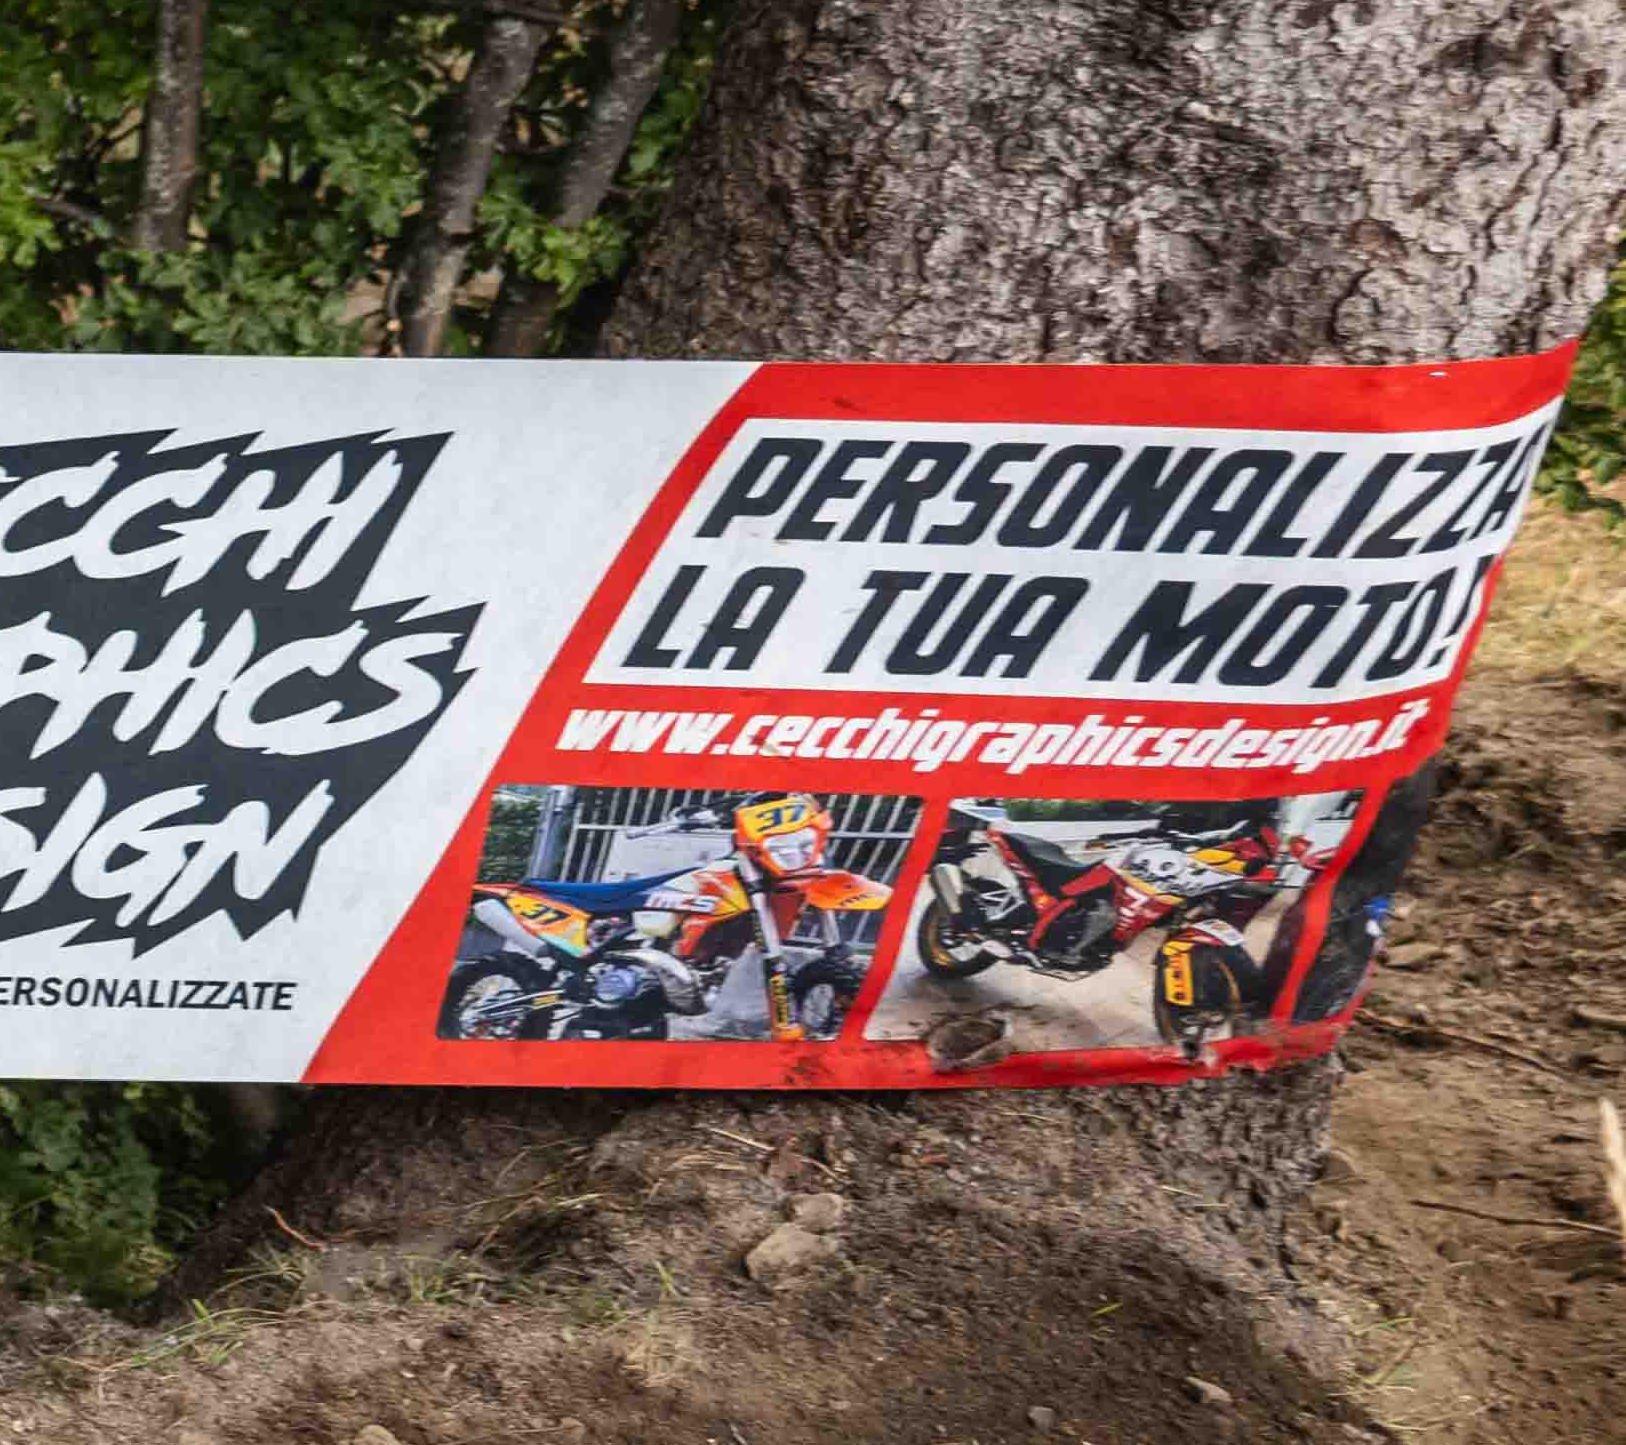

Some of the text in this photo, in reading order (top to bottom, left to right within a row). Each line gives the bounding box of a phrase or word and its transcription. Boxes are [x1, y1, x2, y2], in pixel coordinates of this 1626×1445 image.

[696, 418, 1553, 559] PERSONALIZZA
[620, 554, 1499, 689] LA TUA MOTO!
[555, 697, 1431, 776] www.cecchigraphicsdesign.it
[754, 801, 809, 832] 37
